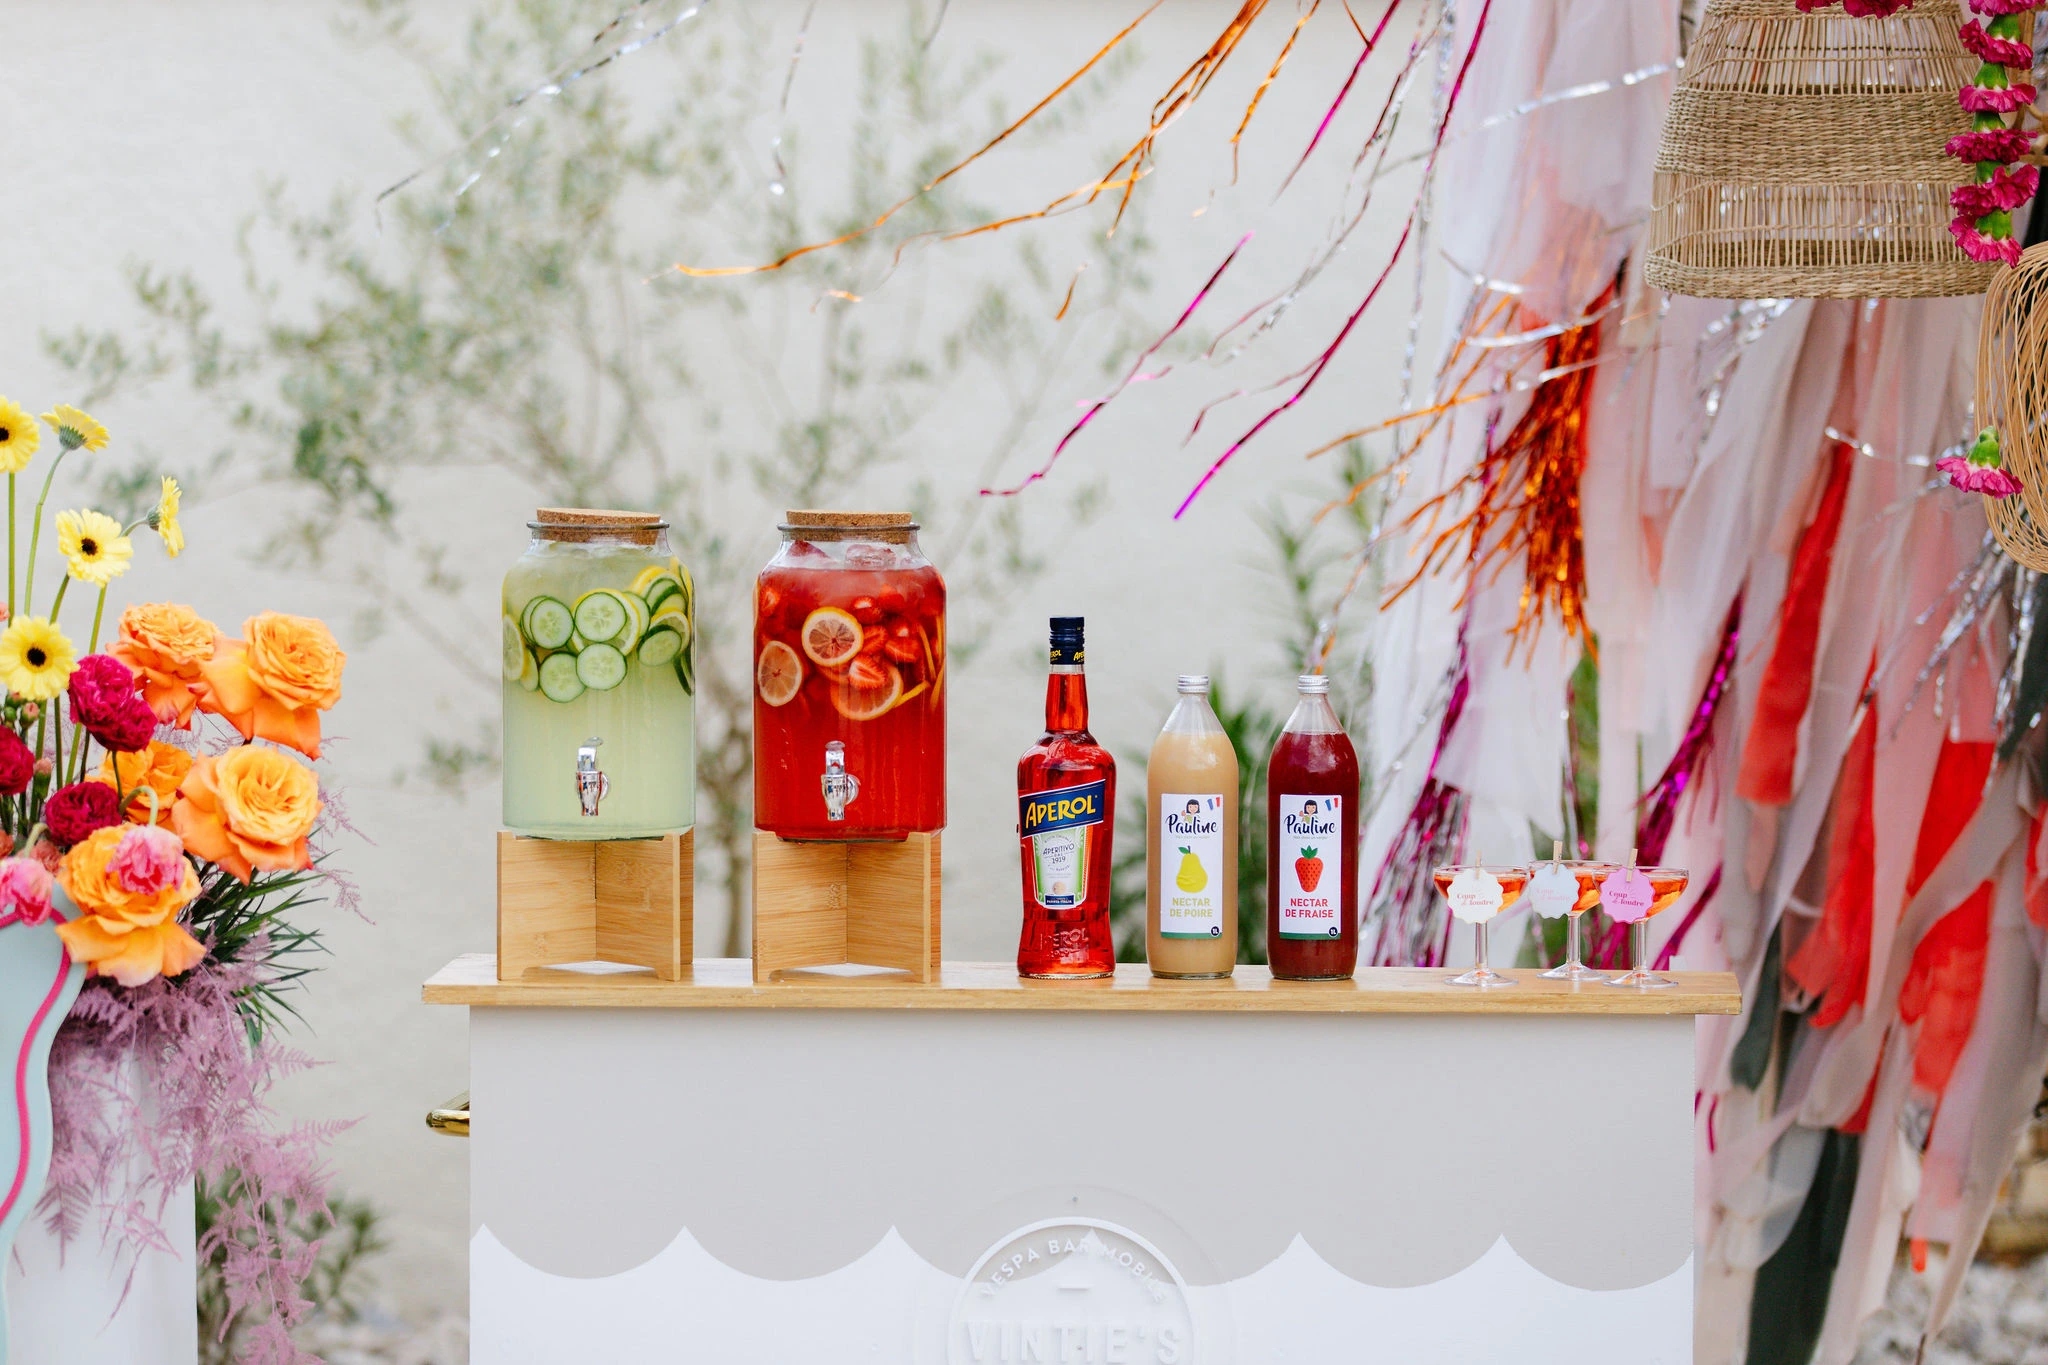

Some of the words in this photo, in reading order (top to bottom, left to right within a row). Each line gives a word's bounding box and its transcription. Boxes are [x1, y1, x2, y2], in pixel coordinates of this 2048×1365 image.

[1025, 794, 1096, 829] APEROL
[1165, 813, 1218, 834] Pauline
[1284, 813, 1337, 835] Pauline
[1042, 843, 1075, 855] APERITIVO
[1052, 856, 1066, 864] 1919
[1172, 897, 1211, 907] NECTAR
[1290, 898, 1329, 907] NECTAR
[1169, 909, 1183, 918] DE
[1184, 909, 1213, 918] POIRE
[1285, 909, 1296, 918] DE
[1299, 909, 1334, 918] FRAISE
[980, 1247, 1041, 1297] VESPA
[1048, 1239, 1090, 1256] BAR
[1099, 1243, 1169, 1304] MOBILE
